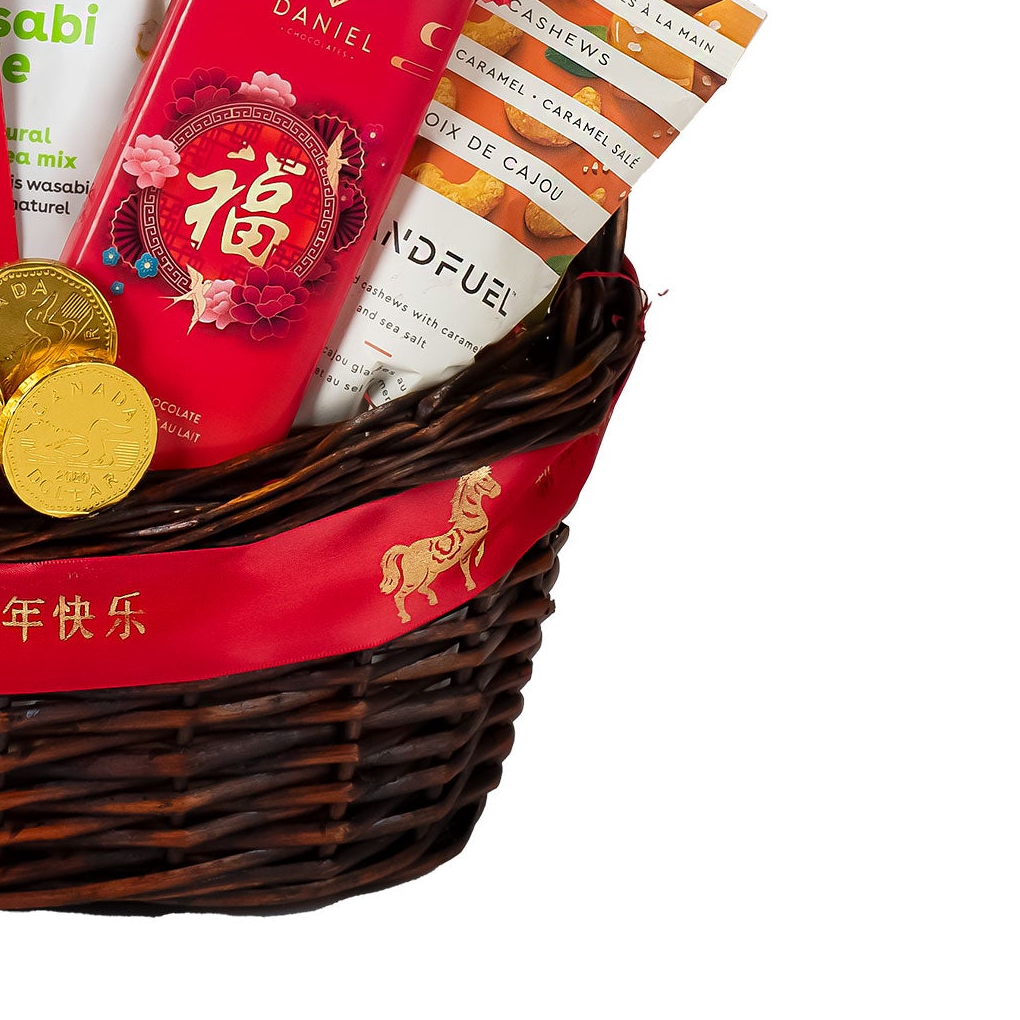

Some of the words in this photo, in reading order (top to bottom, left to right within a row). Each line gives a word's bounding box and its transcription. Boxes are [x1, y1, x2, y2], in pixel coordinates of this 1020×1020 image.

[640, 2, 651, 17] À
[656, 13, 673, 30] LA
[678, 27, 716, 55] MAIN
[456, 49, 526, 96] CARAMEL
[542, 98, 610, 148] CARAMEL
[612, 143, 642, 170] SALÉ
[37, 150, 79, 169] mix
[425, 112, 462, 141] OIX
[467, 135, 497, 160] DE
[503, 156, 564, 201] CAJOU
[184, 142, 307, 270] 福
[356, 304, 378, 321] and
[379, 316, 400, 335] sea
[403, 329, 428, 350] salt
[361, 282, 409, 312] cashews
[412, 308, 439, 330] with
[322, 345, 349, 367] cajou
[32, 381, 138, 423] CANADA
[326, 374, 340, 387] au
[152, 397, 202, 424] OCOLATE
[160, 421, 177, 434] AU
[177, 427, 201, 443] LAIT
